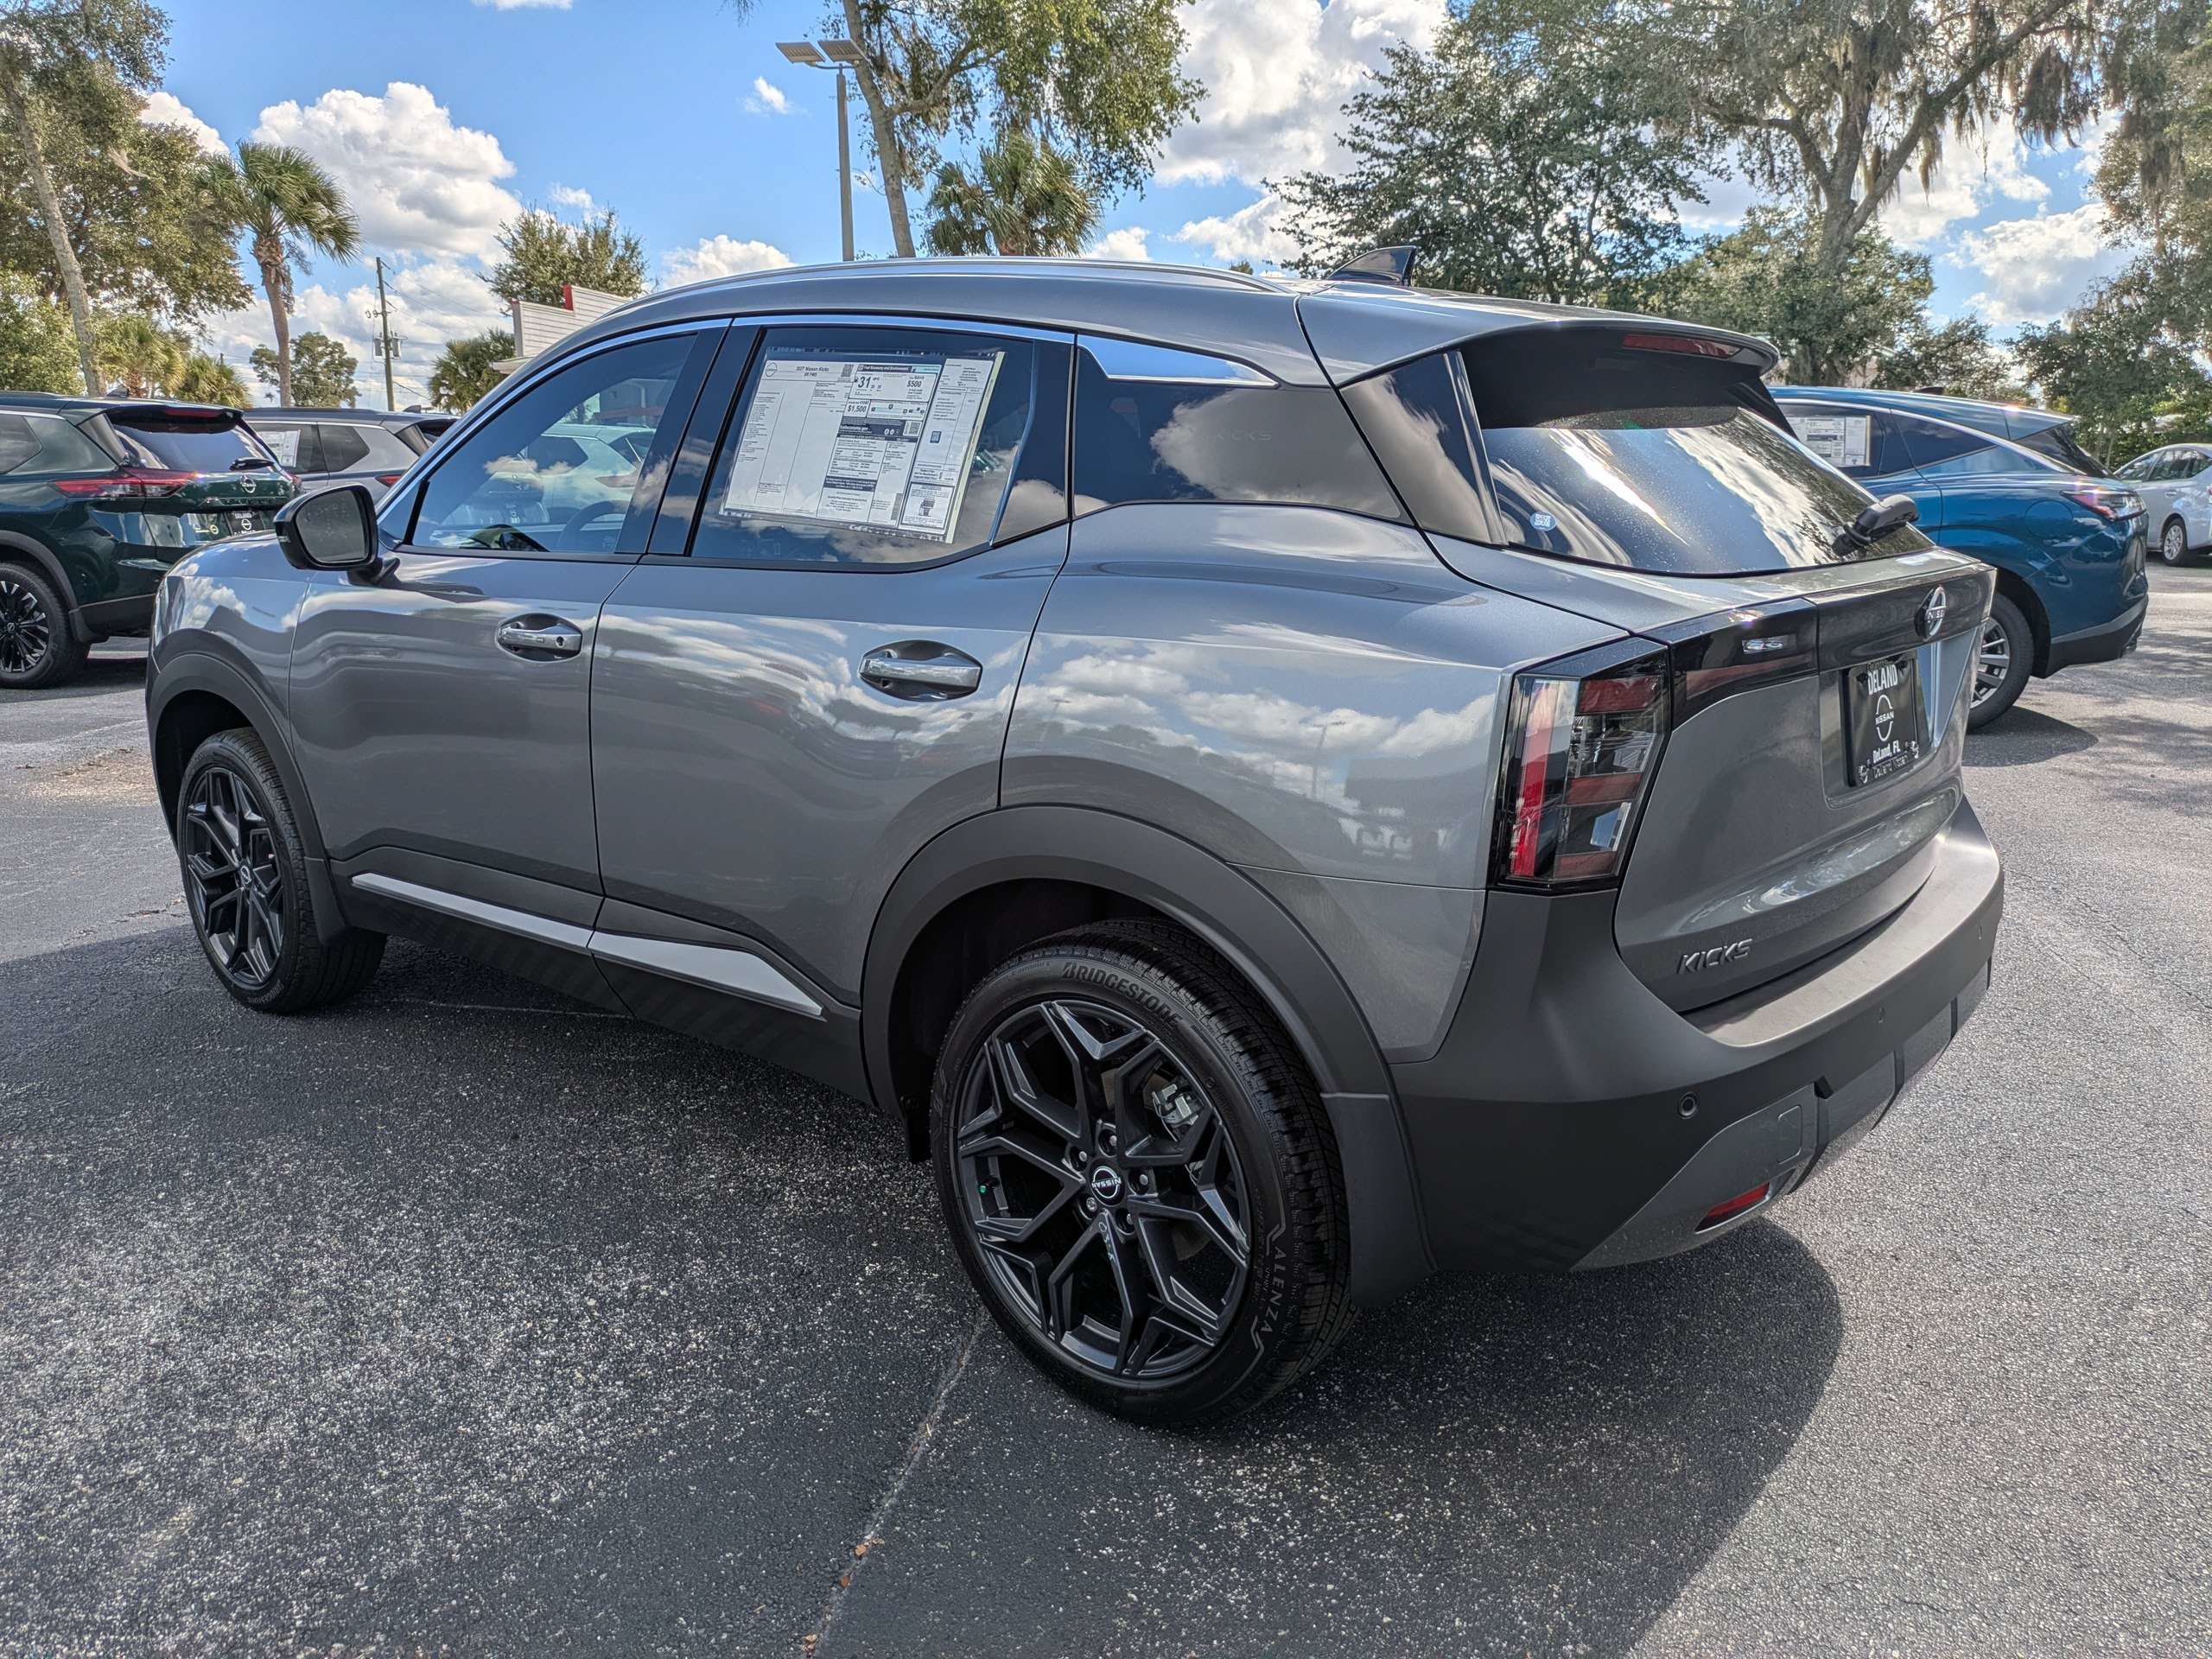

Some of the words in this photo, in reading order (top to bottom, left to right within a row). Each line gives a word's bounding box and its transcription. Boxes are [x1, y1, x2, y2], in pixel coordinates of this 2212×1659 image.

[858, 376, 872, 388] 31
[1867, 664, 1897, 695] DELAND
[1875, 711, 1895, 725] NISSAN
[1676, 938, 1753, 975] KICKS
[1061, 961, 1184, 1027] BRIDGESTONE
[1091, 1176, 1122, 1188] NISSAN
[1260, 1246, 1287, 1333] ALENZA
